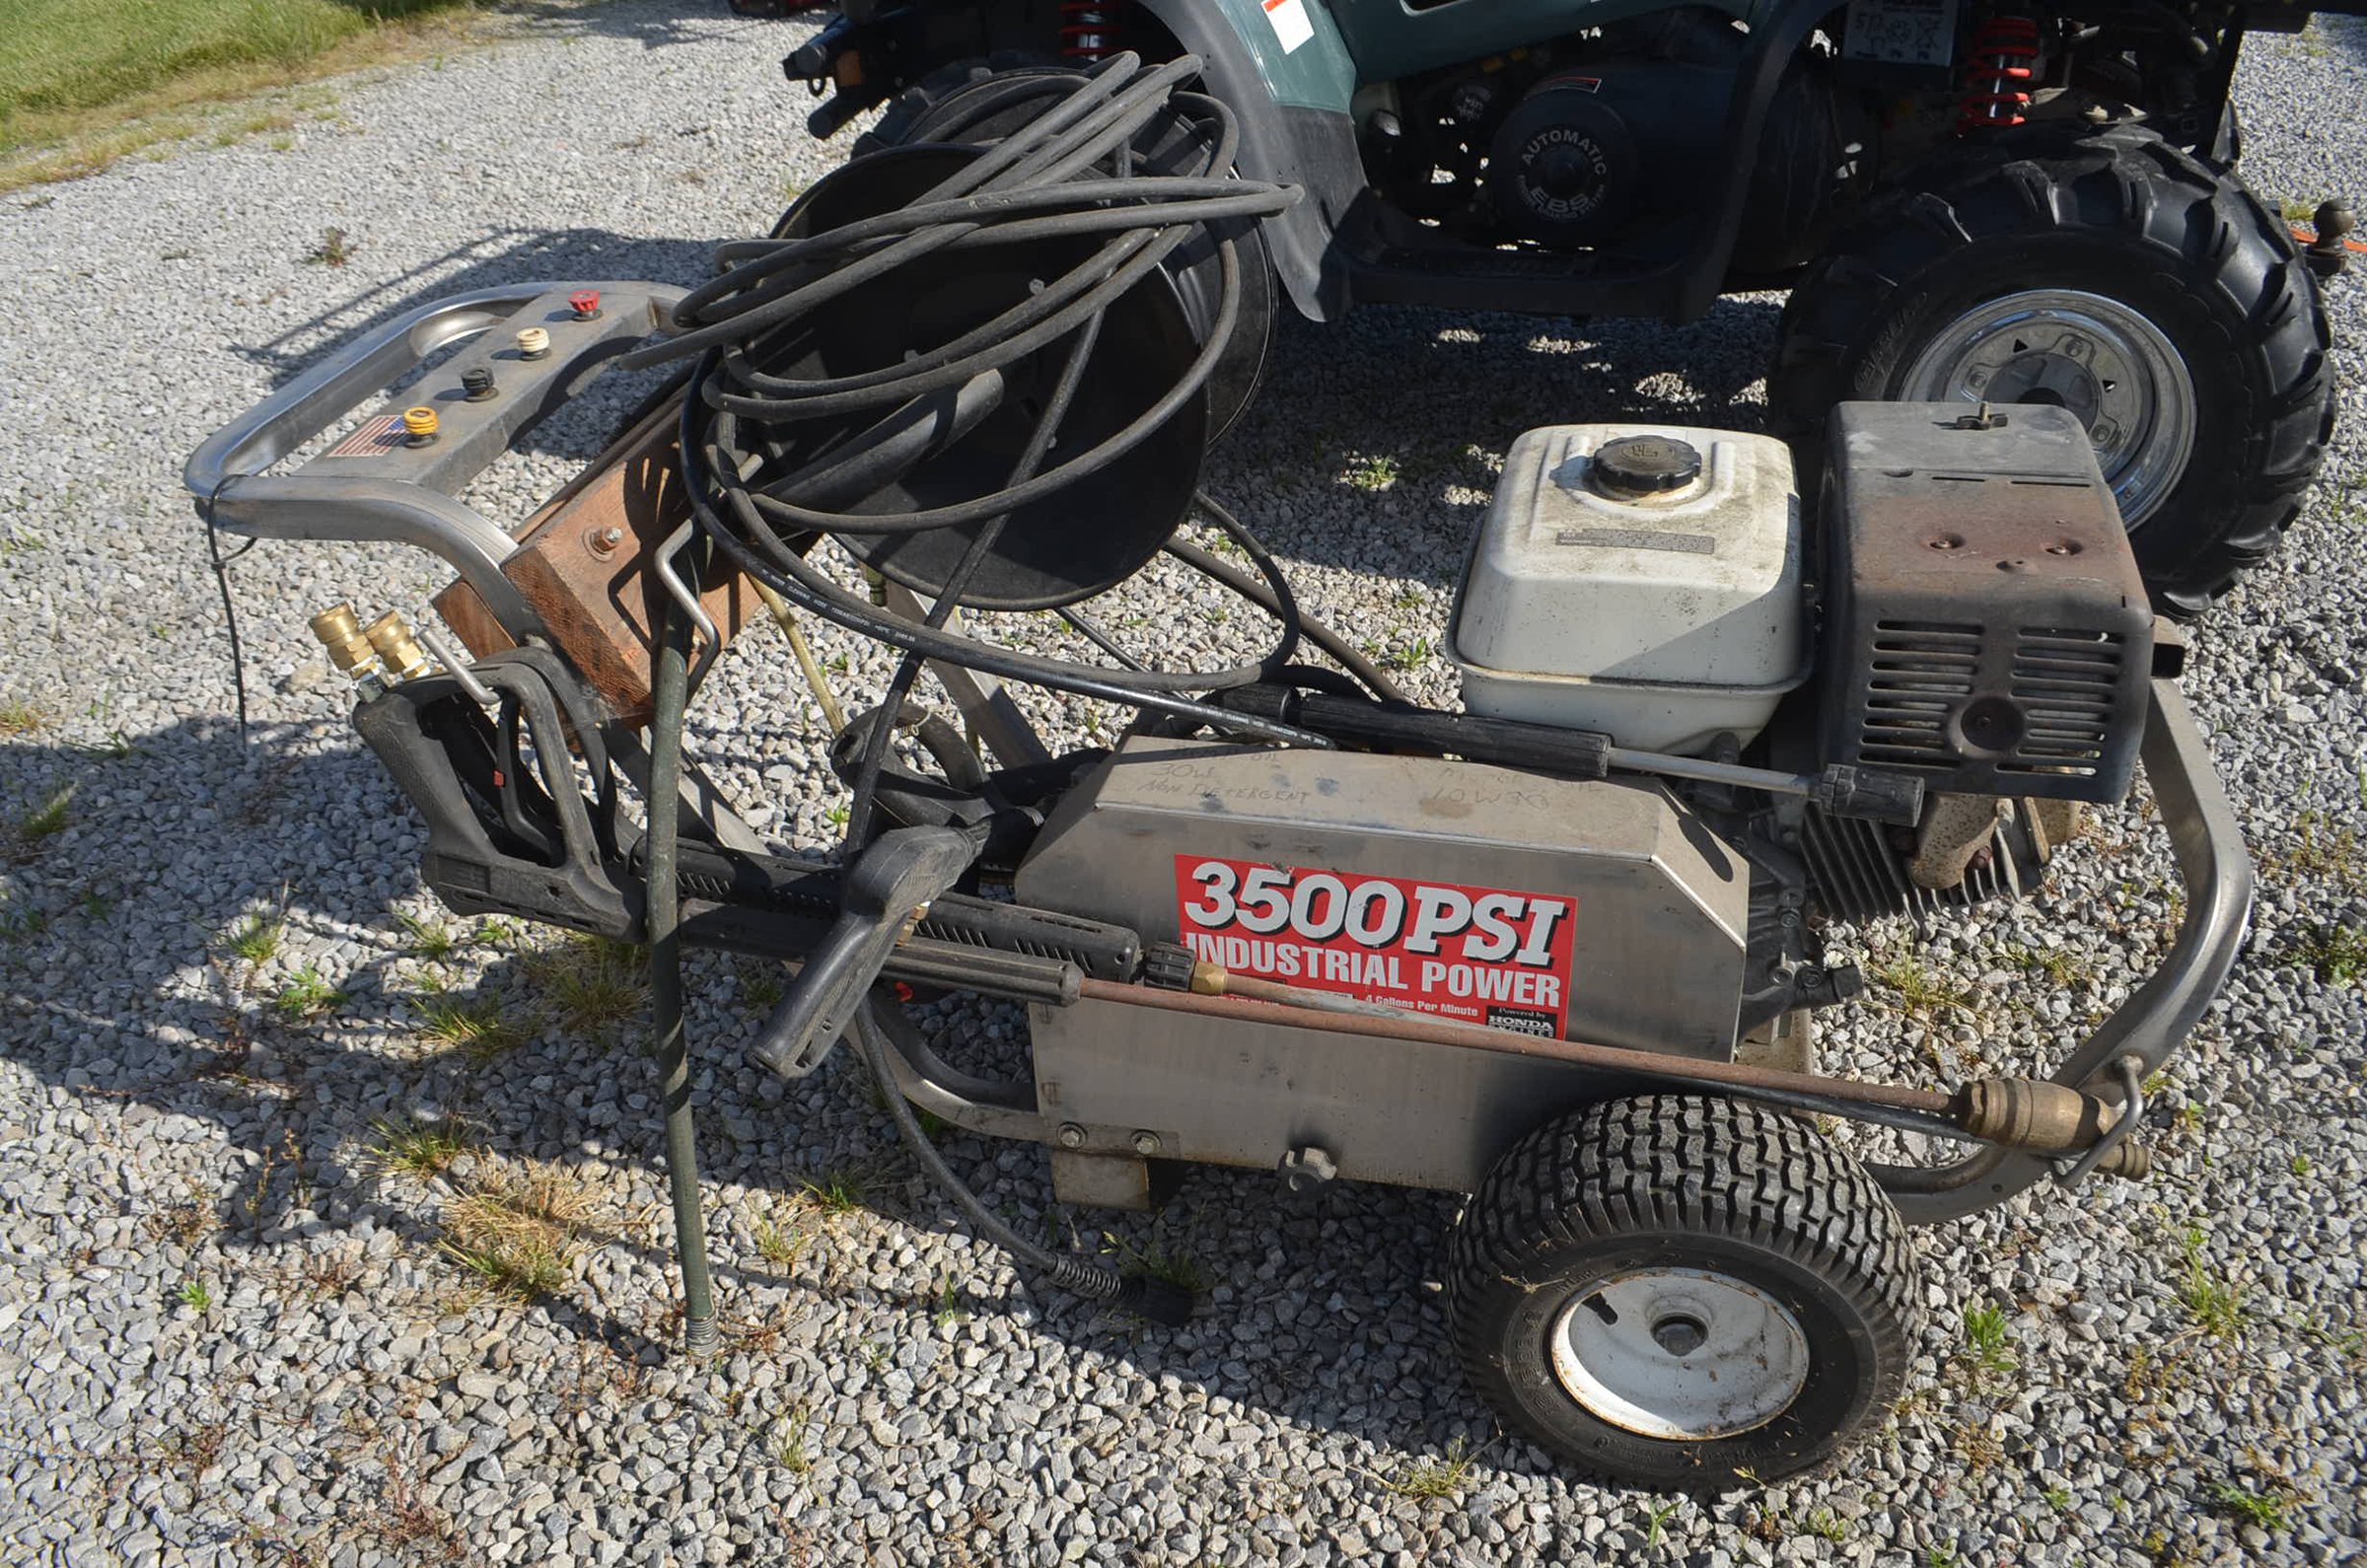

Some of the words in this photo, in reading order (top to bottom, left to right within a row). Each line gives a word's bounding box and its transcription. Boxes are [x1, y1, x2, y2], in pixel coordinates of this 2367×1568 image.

[1522, 129, 1608, 176] AUTOMATIC
[1529, 185, 1590, 213] EBS
[1186, 932, 1408, 990] INDUSTRIAL
[1421, 961, 1560, 1007] POWER
[1366, 994, 1373, 1003] 4
[1376, 995, 1414, 1009] Gallons
[1417, 1000, 1437, 1011] Per
[1440, 1003, 1478, 1017] Minute
[1488, 1015, 1553, 1031] HONDA
